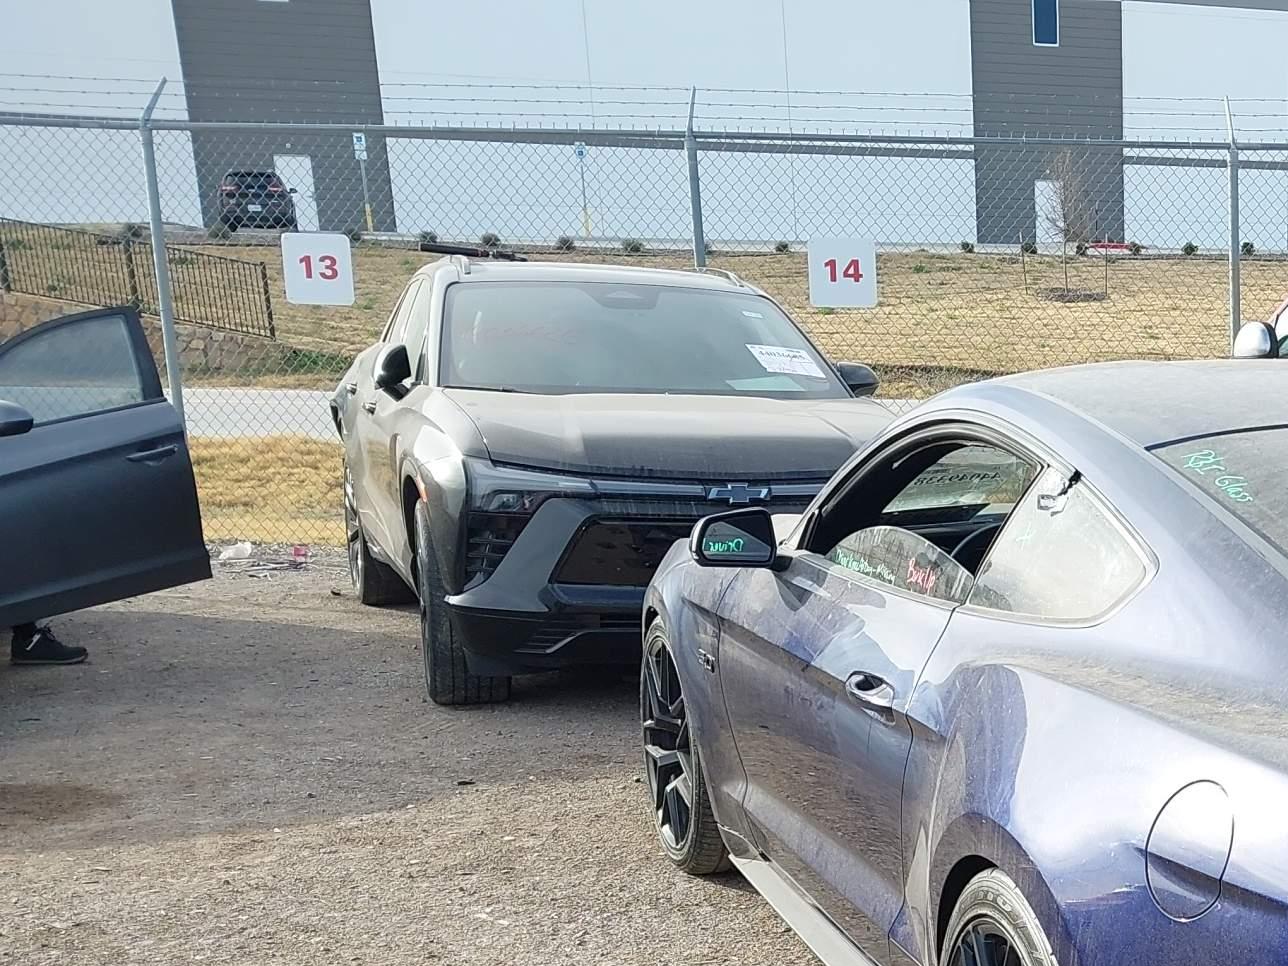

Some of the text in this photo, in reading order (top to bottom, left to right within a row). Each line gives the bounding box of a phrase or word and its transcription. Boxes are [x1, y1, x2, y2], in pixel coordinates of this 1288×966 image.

[298, 255, 339, 279] 13
[824, 258, 864, 282] 14
[1214, 475, 1254, 502] Glass
